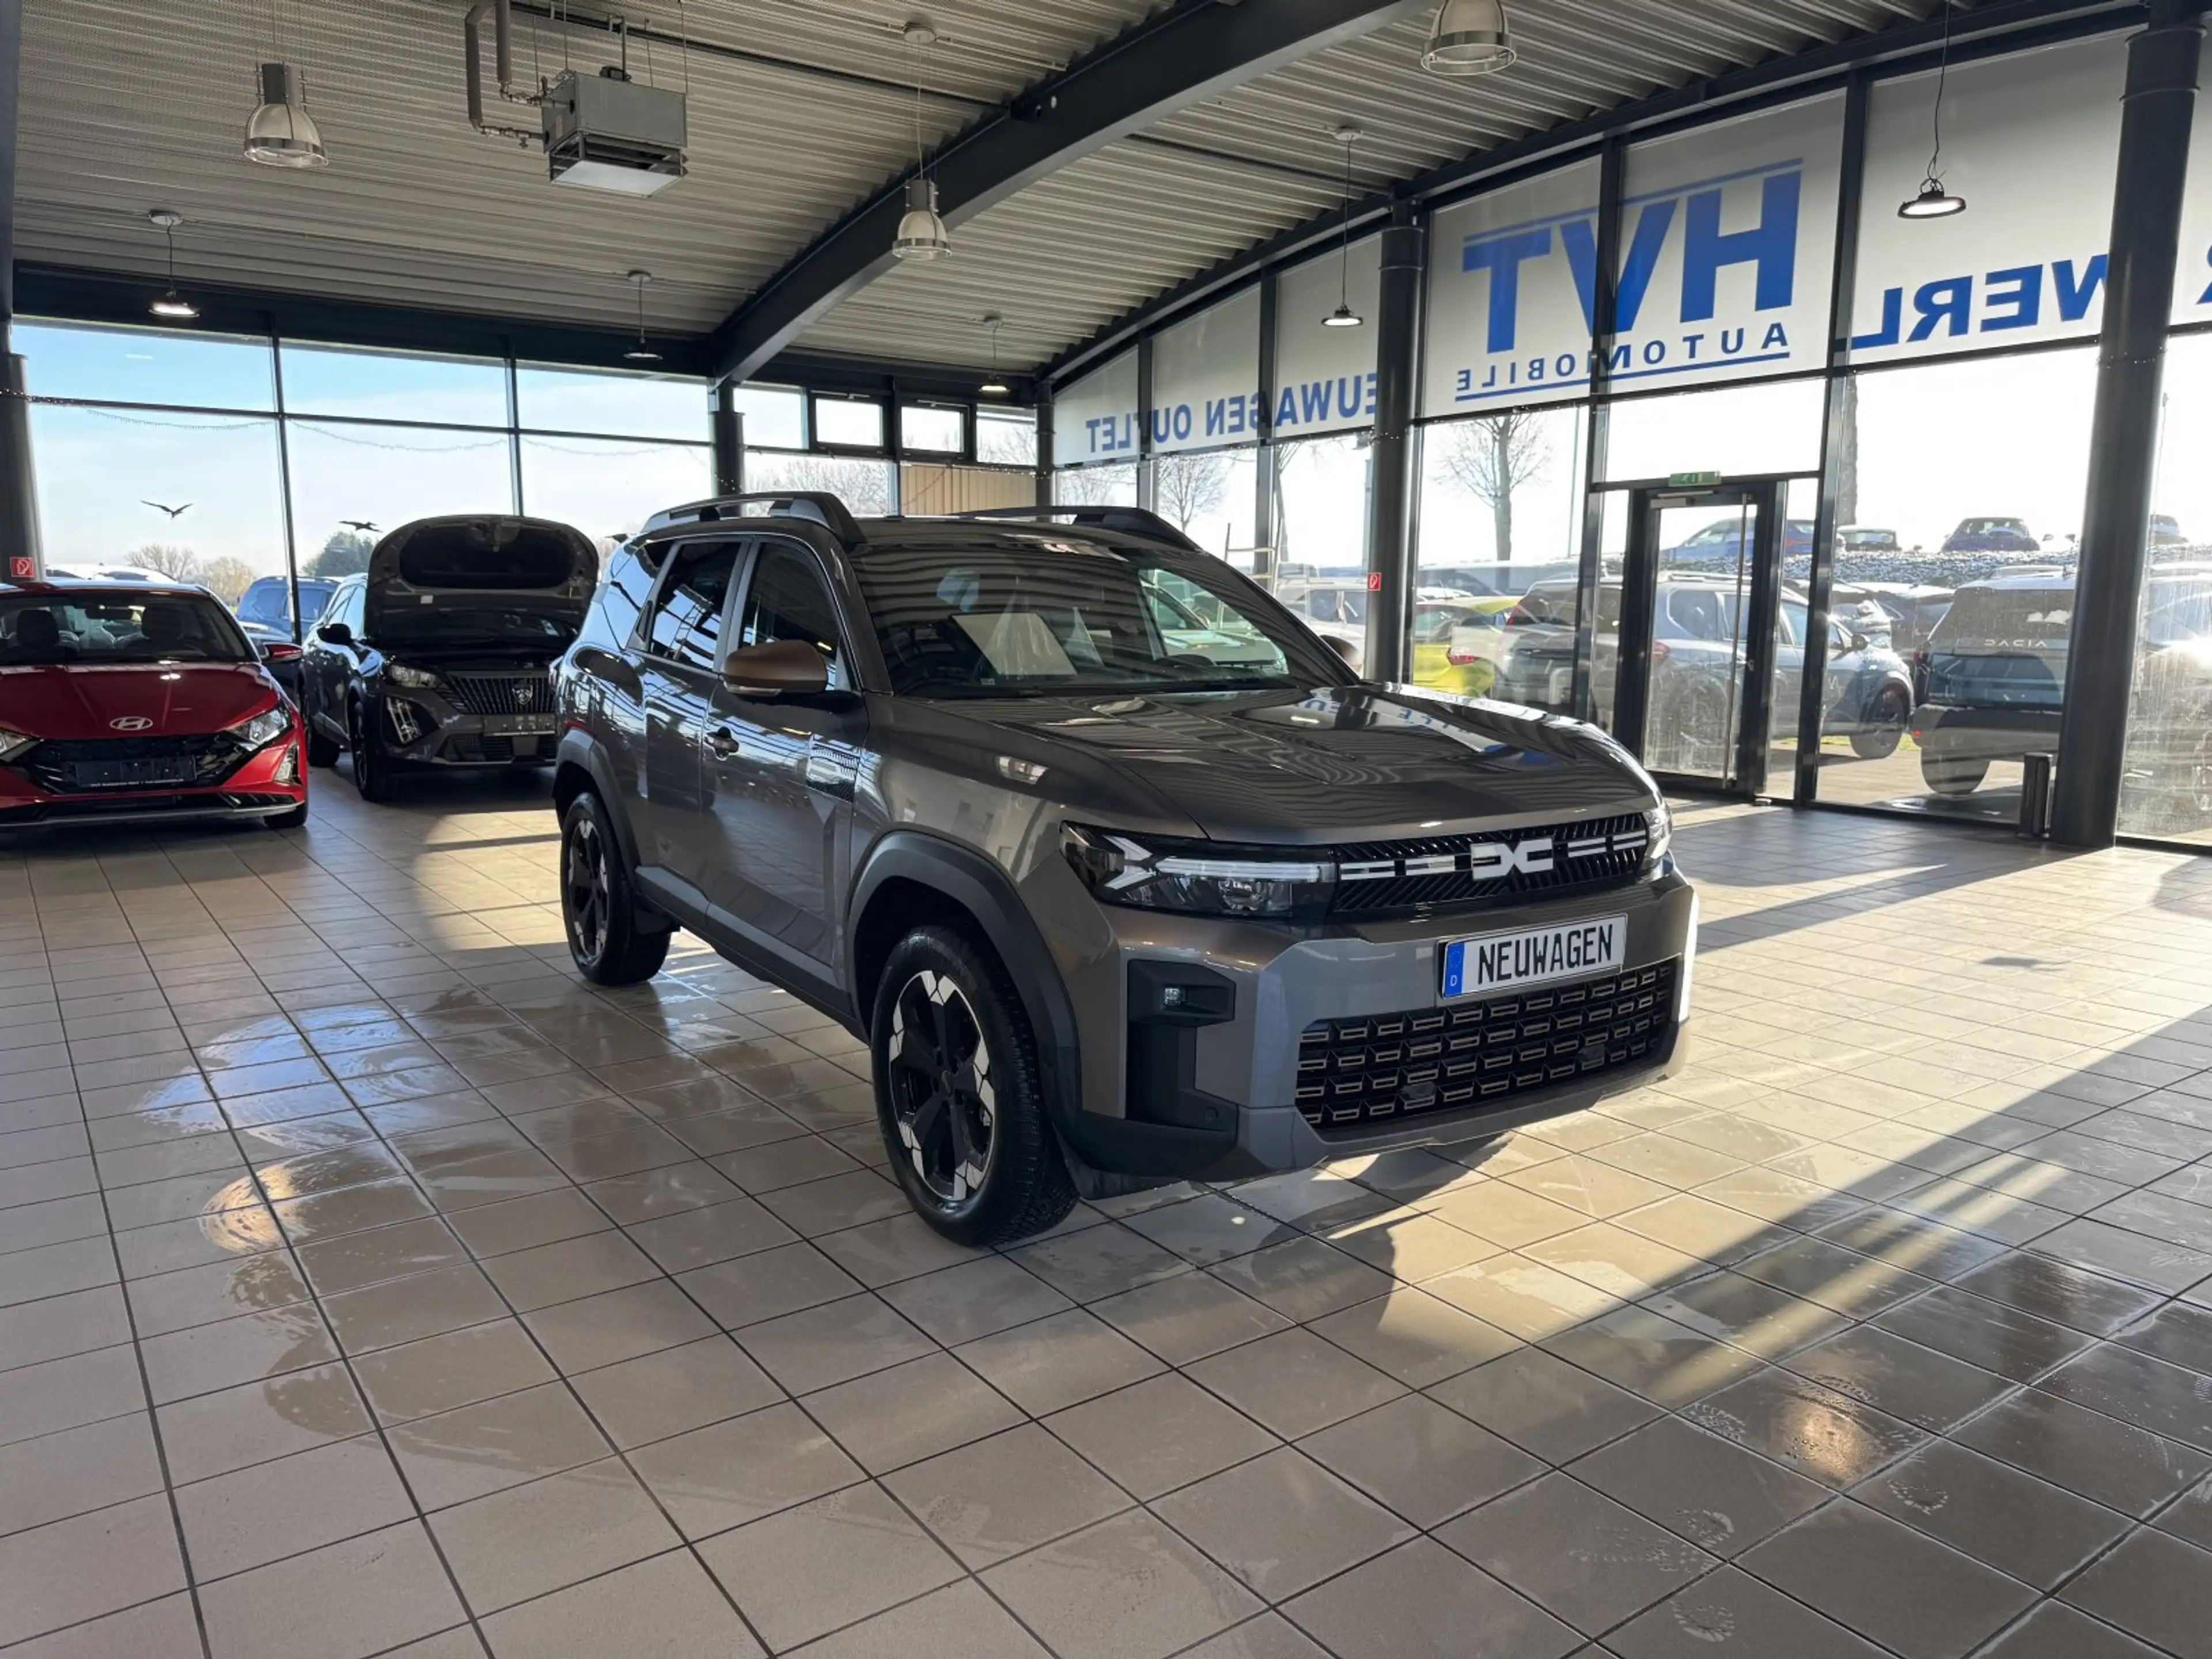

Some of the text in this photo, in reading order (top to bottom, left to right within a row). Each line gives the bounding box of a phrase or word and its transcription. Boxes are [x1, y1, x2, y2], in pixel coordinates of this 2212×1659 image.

[1983, 638, 2048, 648] DACIA
[1478, 923, 1613, 985] NEUWAGEN
[1449, 975, 1458, 987] D
